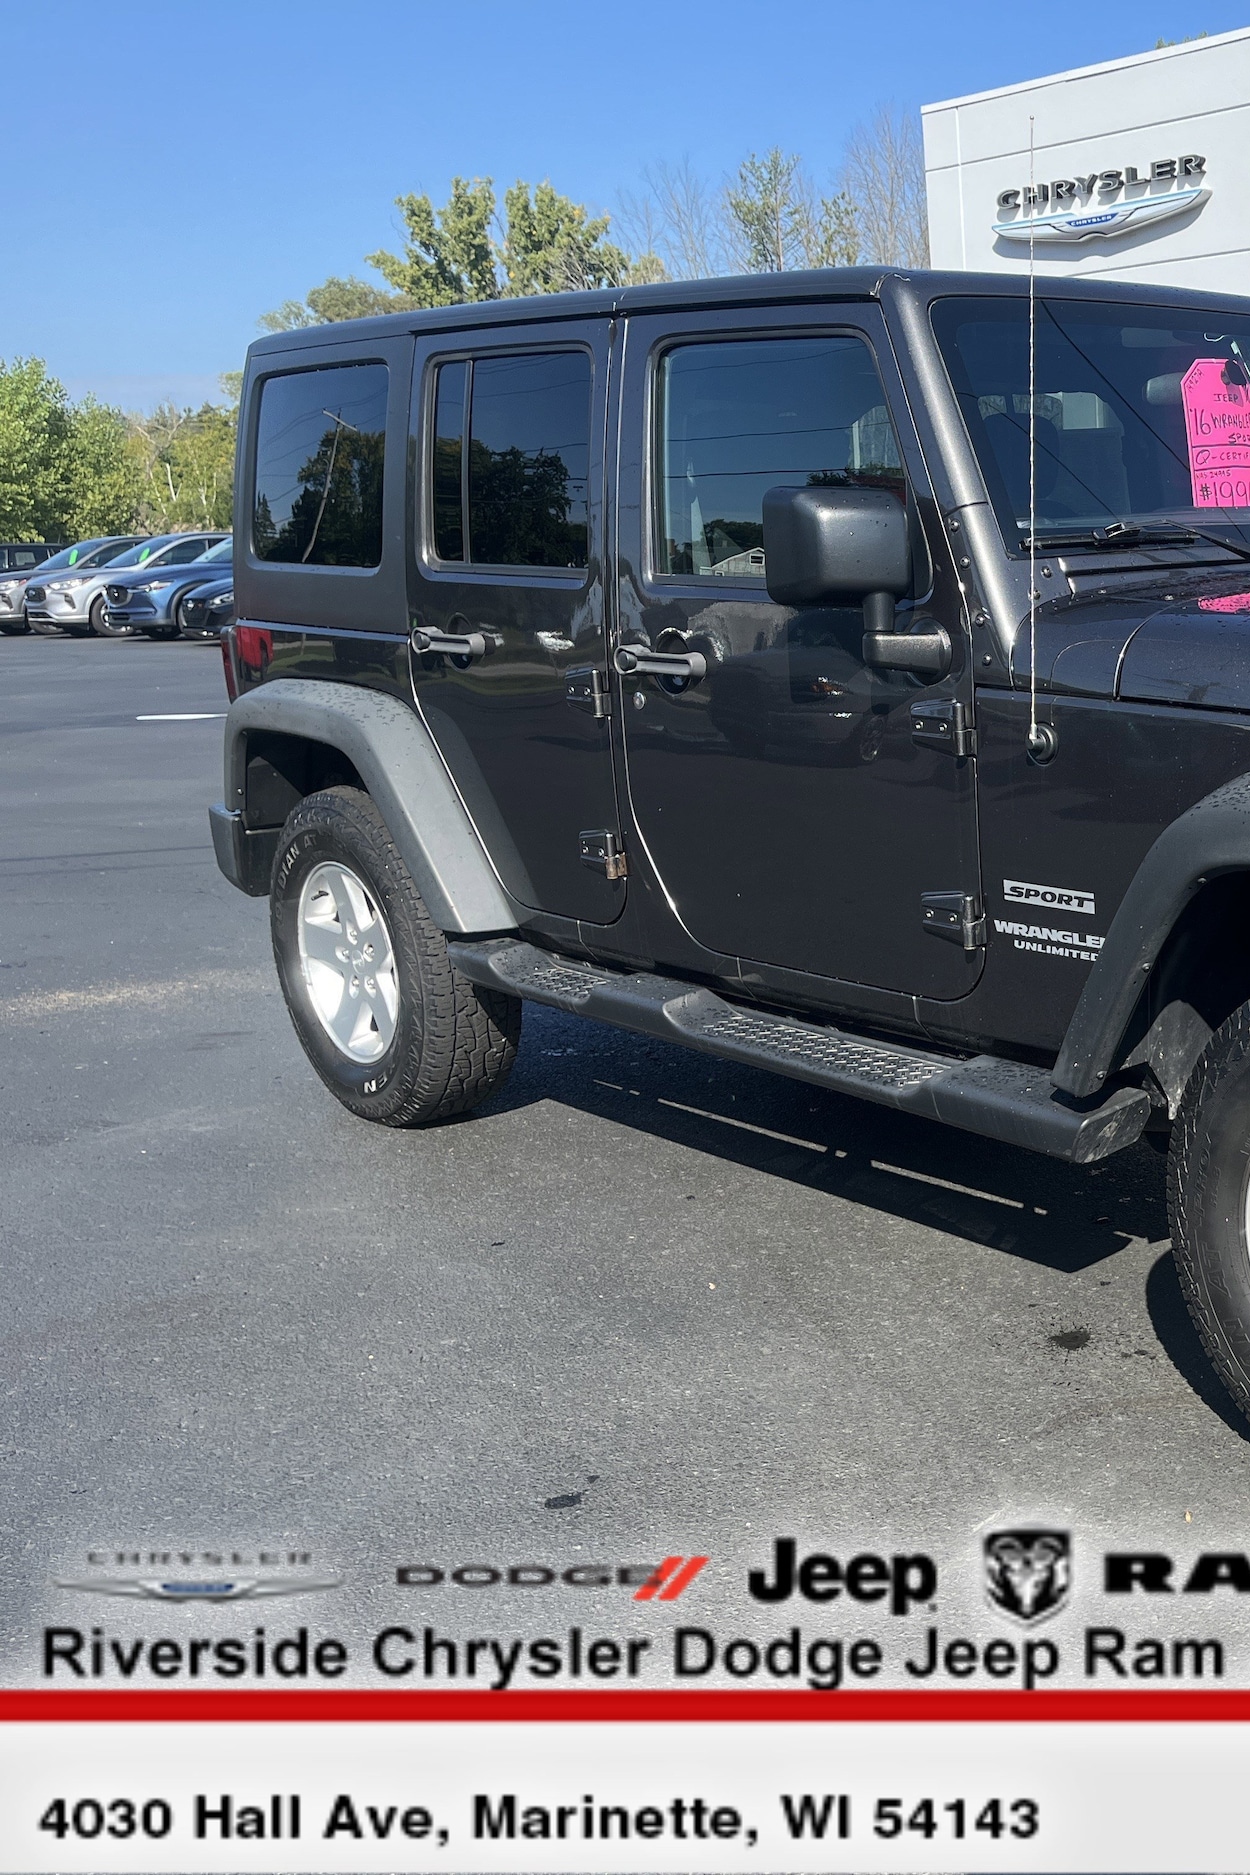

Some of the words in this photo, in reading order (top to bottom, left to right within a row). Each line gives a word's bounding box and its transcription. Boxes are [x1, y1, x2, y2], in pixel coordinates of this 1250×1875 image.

[996, 154, 1207, 210] CHRYSLER
[1070, 214, 1113, 227] CHRYSLER
[1213, 393, 1239, 403] JEEP
[1004, 885, 1094, 908] SPORT
[1193, 1144, 1212, 1218] PRO
[1200, 1240, 1231, 1299] AT
